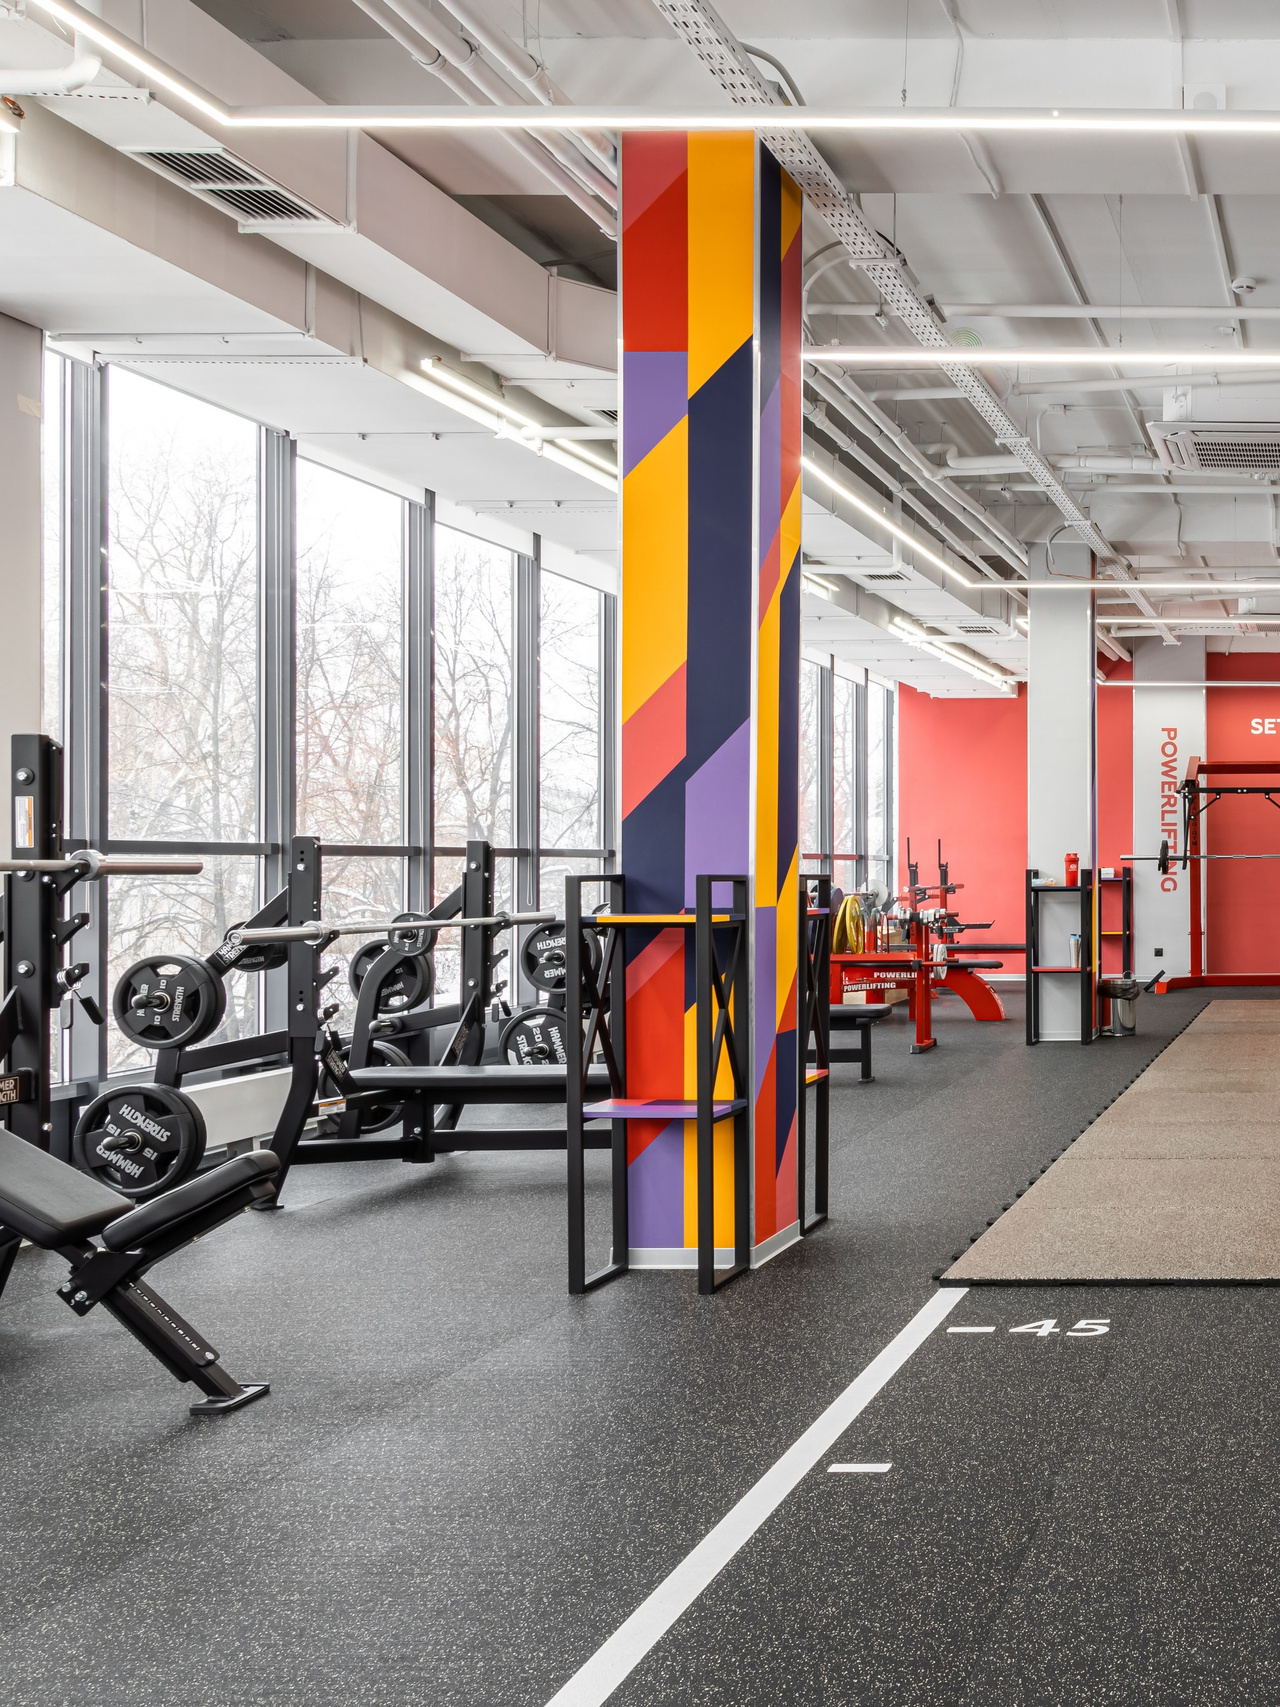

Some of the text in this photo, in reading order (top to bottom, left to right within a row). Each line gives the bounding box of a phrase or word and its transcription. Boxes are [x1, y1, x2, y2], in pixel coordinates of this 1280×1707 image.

[1160, 727, 1178, 893] POWERLIFTNG
[159, 979, 167, 989] 10
[843, 982, 896, 992] POWERLIFTING
[171, 986, 185, 1022] STRENGTH
[153, 1015, 161, 1025] 10
[532, 1027, 543, 1043] 20
[106, 1123, 122, 1137] 15
[118, 1103, 171, 1142] STRENGTH
[142, 1147, 158, 1161] 15
[1008, 1318, 1111, 1337] 45
